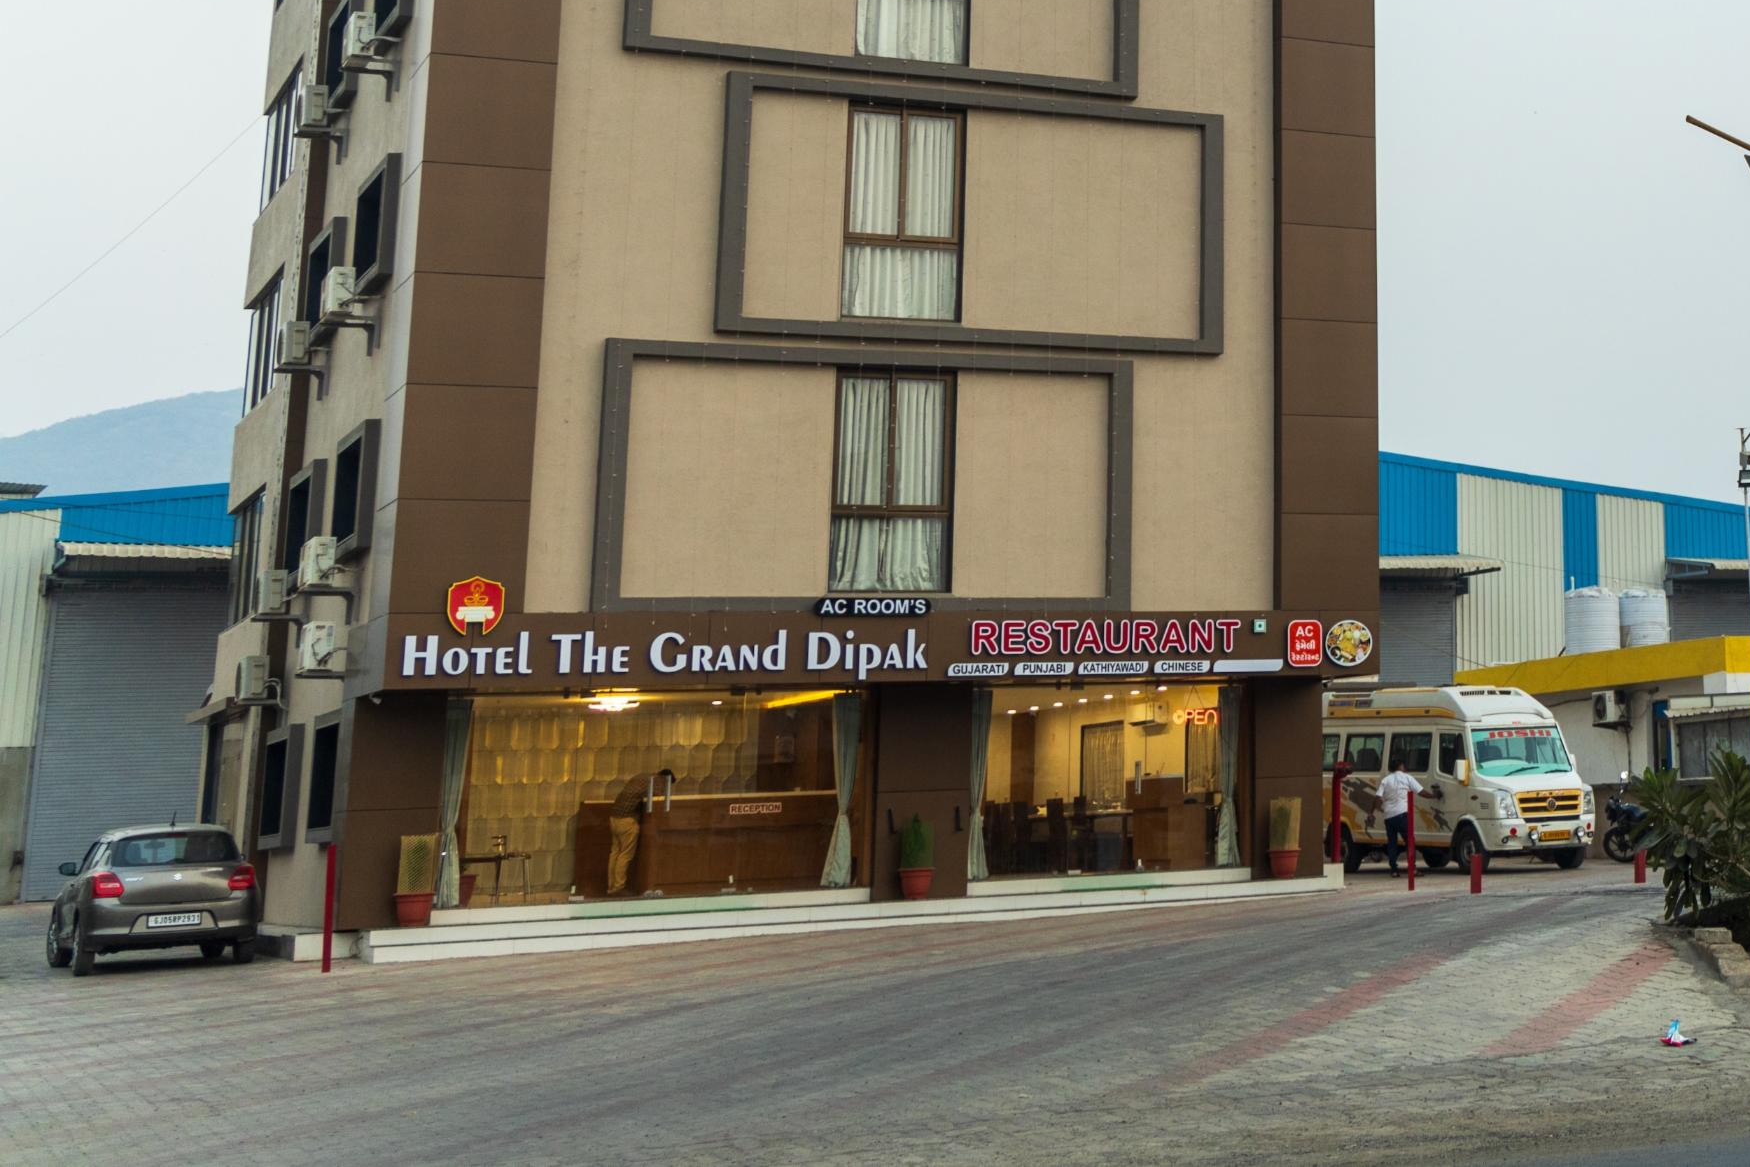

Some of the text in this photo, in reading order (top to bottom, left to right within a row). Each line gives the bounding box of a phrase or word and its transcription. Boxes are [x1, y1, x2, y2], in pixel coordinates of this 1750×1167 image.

[820, 599, 927, 615] AC ROOM'S
[1296, 625, 1314, 637] AC
[971, 619, 1242, 655] RESTAURANT
[952, 664, 1005, 675] GUJARATI
[1022, 663, 1066, 674] PUNJABI
[1082, 663, 1144, 673] KATHIYAWADI
[1161, 662, 1203, 672] CHINESE
[731, 803, 781, 814] RECEPTION
